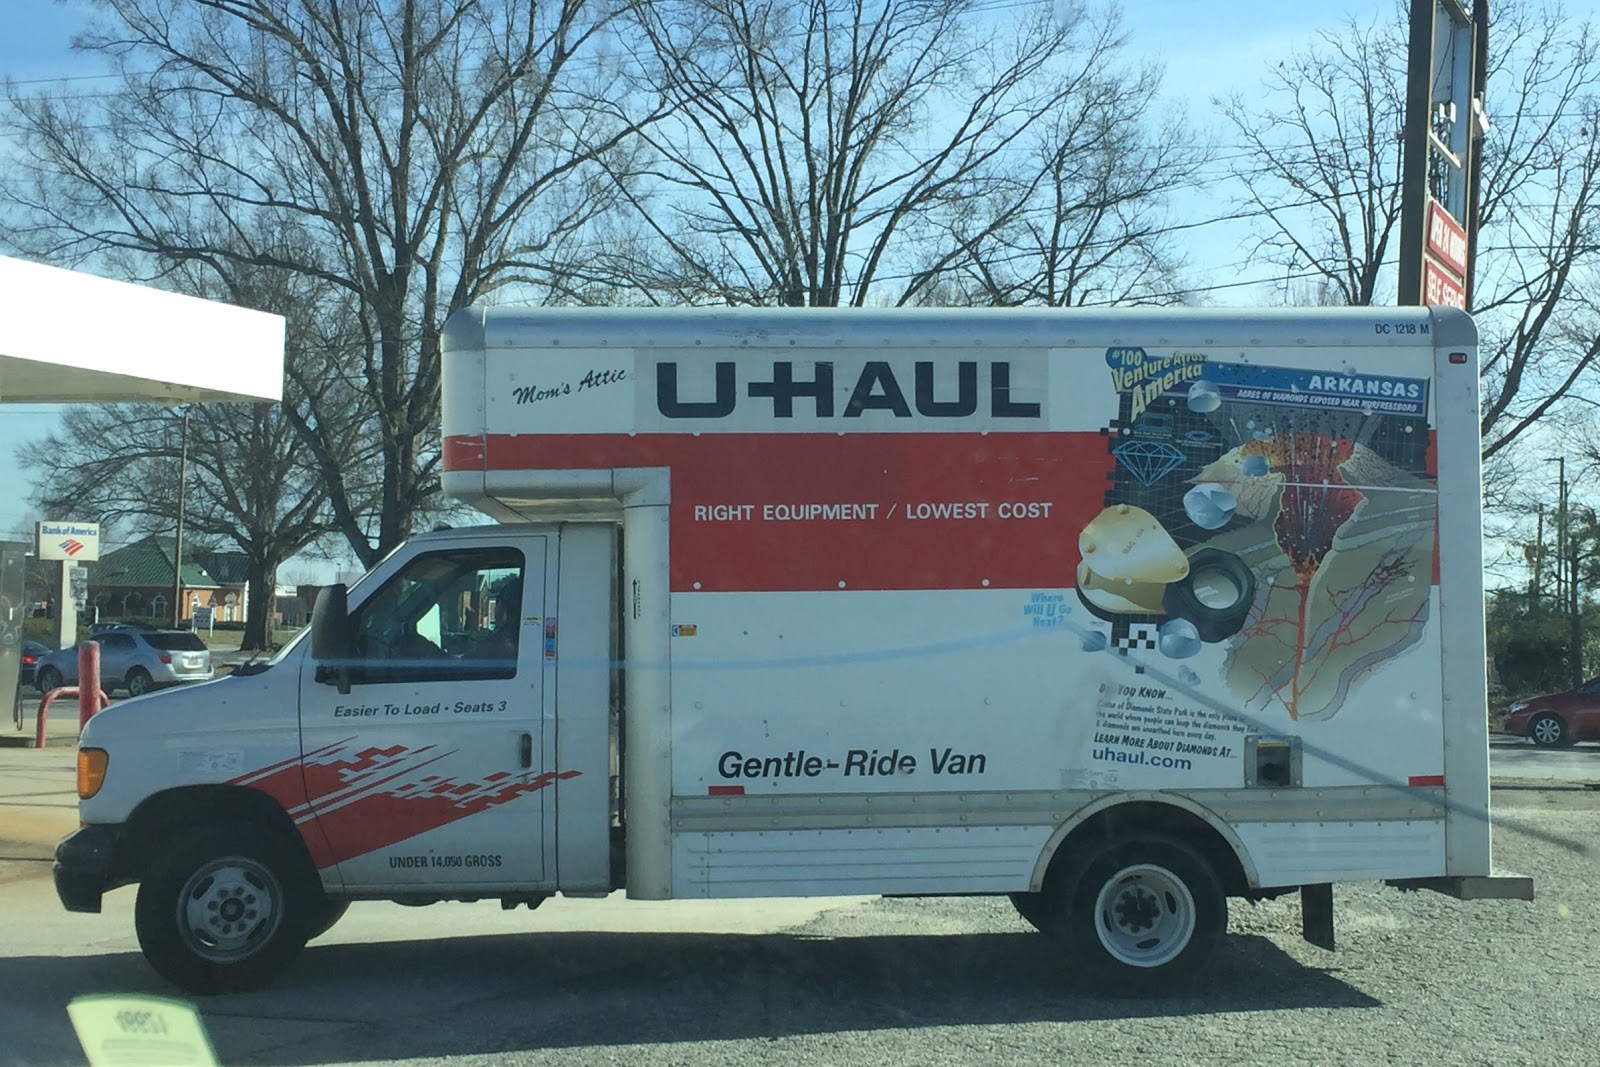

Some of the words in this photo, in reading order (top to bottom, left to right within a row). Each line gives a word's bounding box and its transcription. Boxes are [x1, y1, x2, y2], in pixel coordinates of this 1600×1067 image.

[1427, 269, 1442, 305] SELF
[1375, 323, 1391, 335] DC
[1394, 323, 1416, 335] 1218
[1420, 323, 1430, 335] M
[1112, 349, 1142, 367] #100
[1112, 357, 1171, 393] Venture
[512, 382, 572, 405] Mom's
[577, 369, 627, 393] Attic
[1131, 364, 1202, 423] America
[1308, 375, 1419, 398] ARKANSAS
[1237, 389, 1261, 399] ACRES
[1262, 391, 1271, 400] OF
[1272, 393, 1309, 404] DIAMONDS
[1309, 395, 1340, 406] EXPOSED
[1341, 398, 1360, 408] NEAR
[1361, 399, 1418, 412] MURFREESBORO
[694, 504, 755, 521] RIGHT
[763, 503, 879, 520] EQUIPMENT
[905, 502, 989, 519] LOWEST
[997, 502, 1053, 519] COST
[42, 525, 61, 535] Bank
[62, 526, 70, 535] of
[70, 526, 97, 536] America
[1031, 591, 1064, 603] Where
[1023, 604, 1044, 615] Will
[1046, 603, 1056, 617] U
[1058, 604, 1072, 615] Go
[1032, 616, 1064, 627] Next?
[1118, 684, 1137, 697] YOU
[334, 705, 379, 717] Easier
[383, 704, 400, 716] To
[404, 703, 441, 715] Load
[453, 701, 494, 714] Seats
[497, 700, 507, 712] 3
[1117, 701, 1125, 710] of
[1126, 701, 1155, 713] Diamonds
[1156, 706, 1172, 715] State
[1174, 707, 1188, 716] Park
[1208, 711, 1220, 720] only
[1102, 720, 1129, 730] diamonds
[1142, 726, 1171, 735] unearthed
[1172, 728, 1185, 737] here
[1187, 731, 1202, 740] every
[1107, 711, 1123, 720] world
[1143, 716, 1162, 725] people
[1232, 724, 1245, 733] they
[1094, 732, 1120, 745] LEARN
[1121, 735, 1146, 748] MORE
[1146, 738, 1175, 751] ABOUT
[1176, 741, 1218, 757] DIAMONDS
[930, 748, 987, 775] Van
[1092, 747, 1192, 770] uhaul.com
[389, 856, 428, 868] UNDER
[430, 855, 462, 868] 14,050
[464, 855, 502, 867] GROSS
